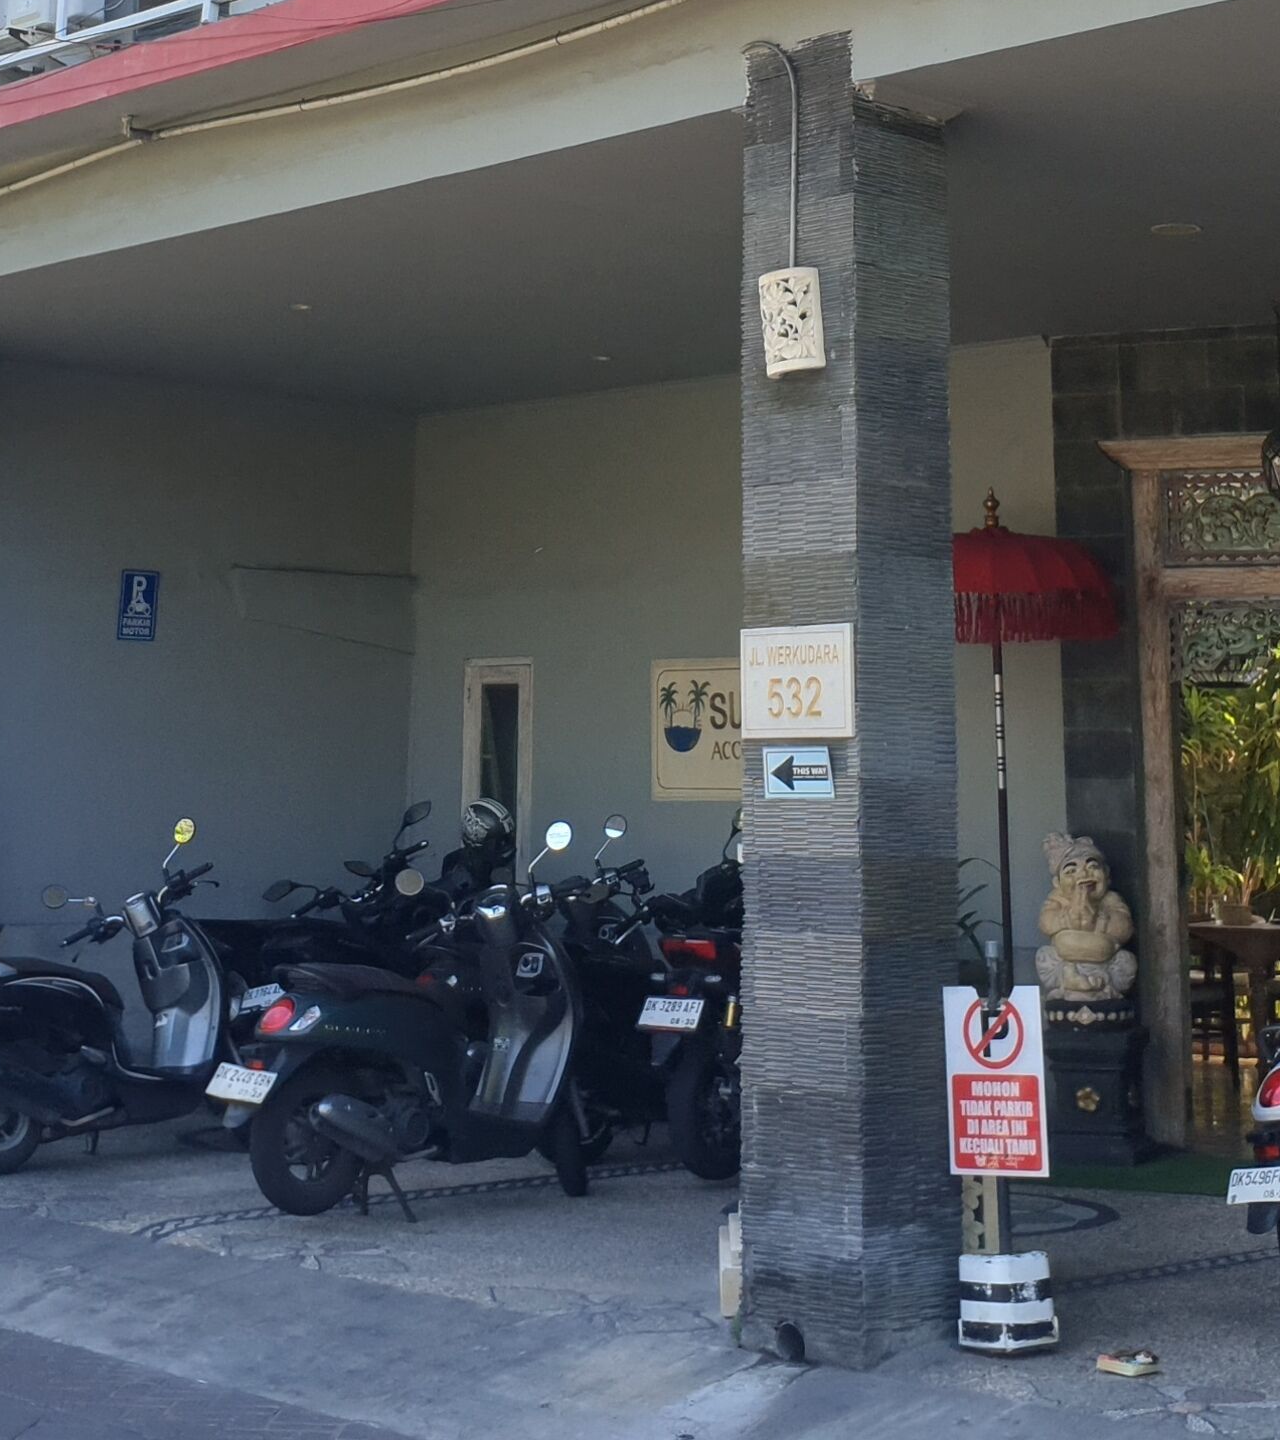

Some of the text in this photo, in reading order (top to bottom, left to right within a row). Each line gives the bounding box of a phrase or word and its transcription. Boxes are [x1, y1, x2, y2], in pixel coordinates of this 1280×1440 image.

[122, 617, 151, 627] PARKIR
[122, 627, 150, 636] MOTOR
[749, 643, 840, 667] JL. WERKUDARA
[767, 675, 824, 719] 532
[792, 766, 827, 776] THIS WAY
[644, 999, 658, 1012] DK
[659, 1000, 683, 1013] 3289
[971, 1080, 1020, 1097] MOHON
[959, 1100, 1034, 1118] TIDAK PARKIR
[967, 1118, 1028, 1137] DI AREA INI
[959, 1137, 1037, 1156] KECUALI TAMU
